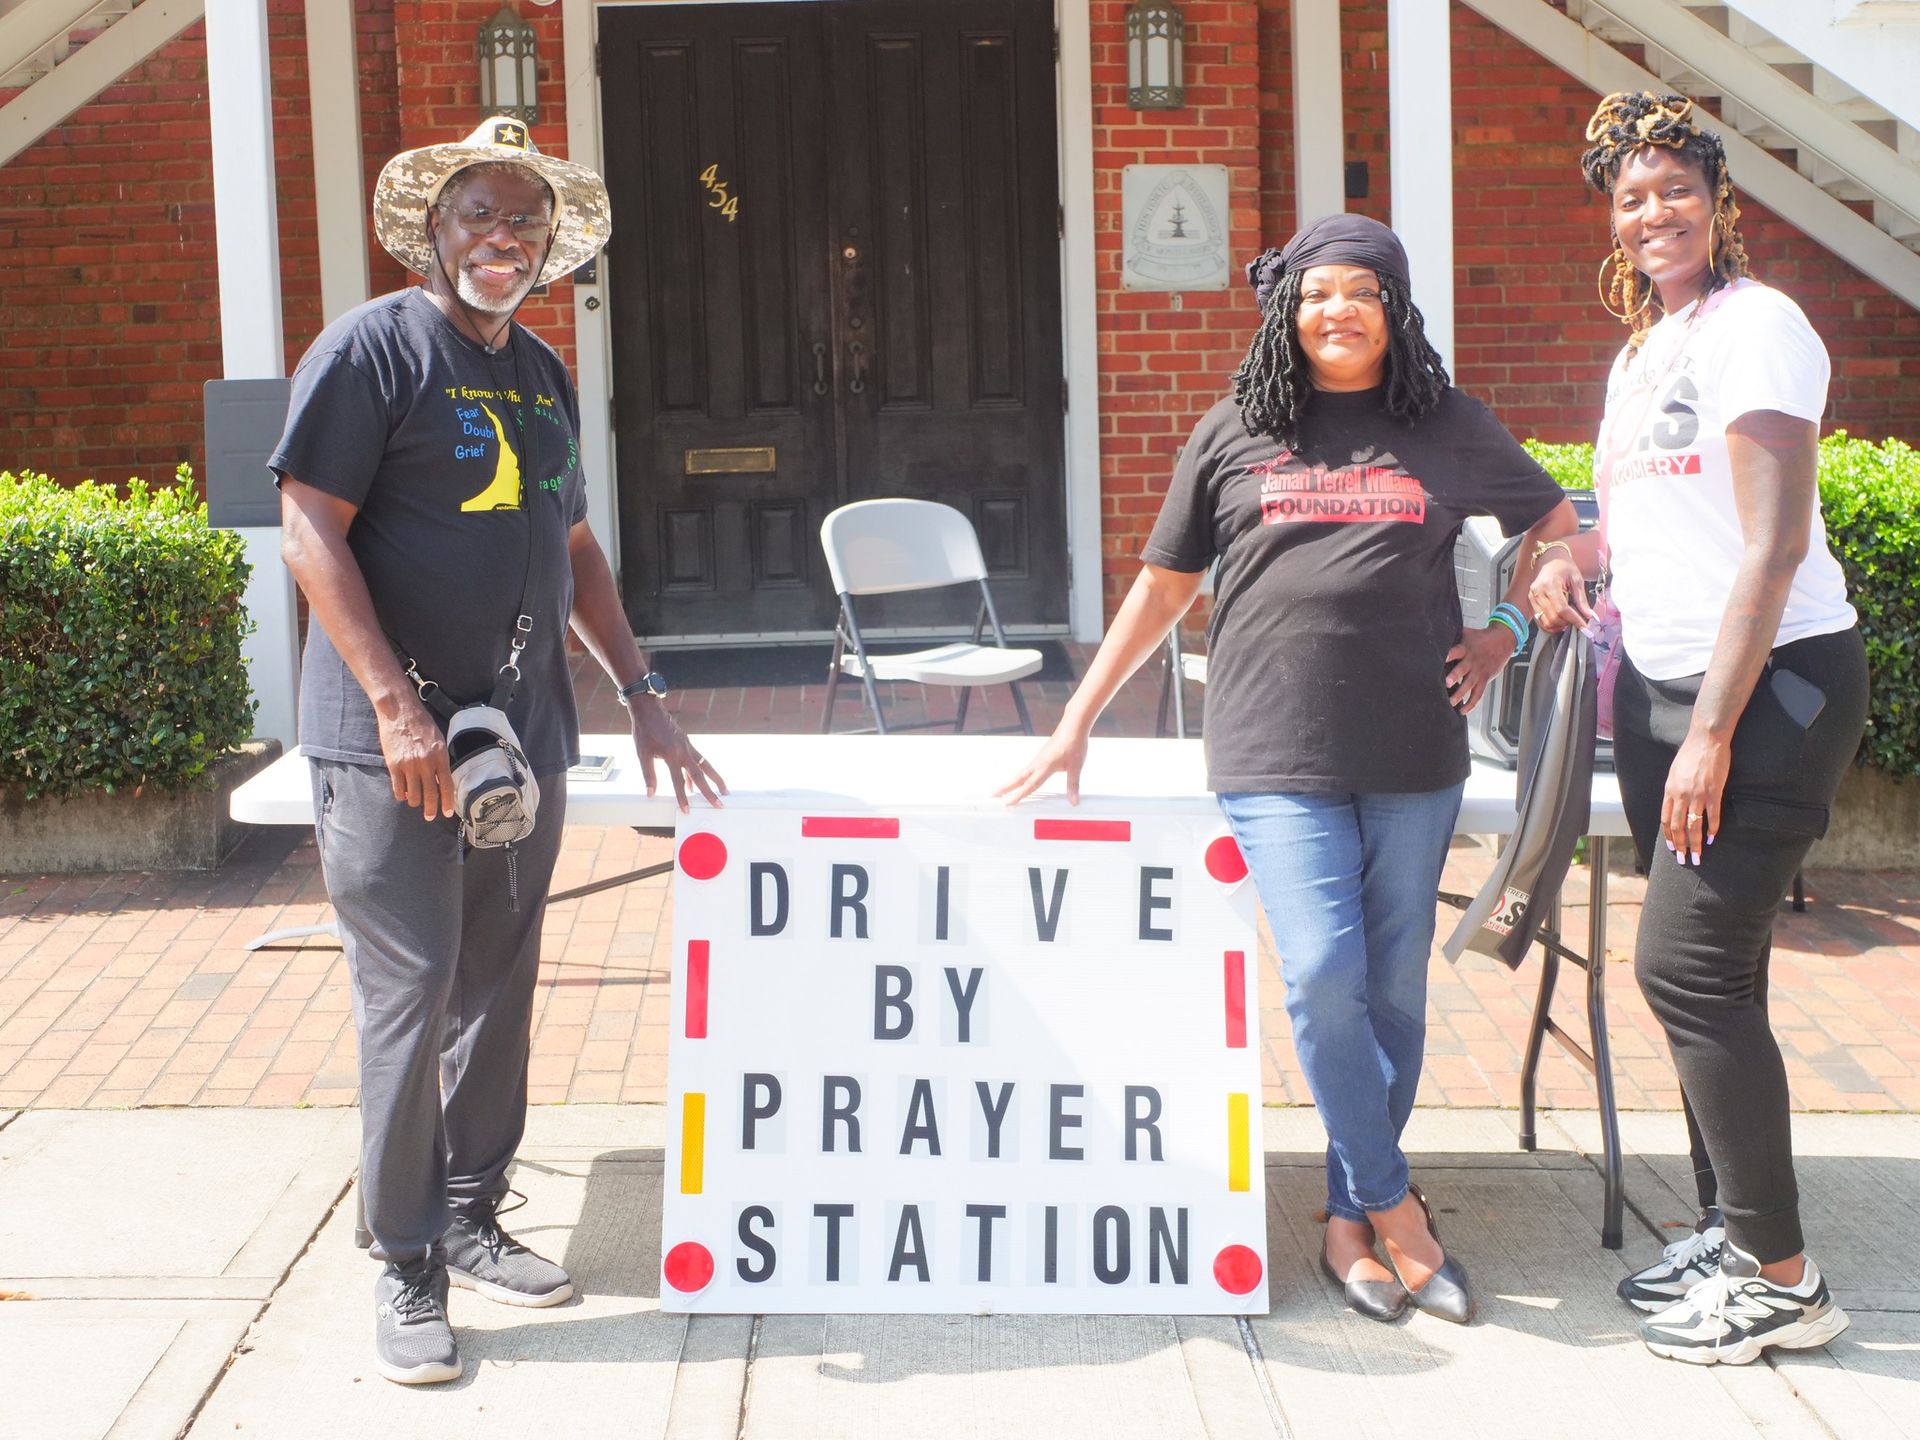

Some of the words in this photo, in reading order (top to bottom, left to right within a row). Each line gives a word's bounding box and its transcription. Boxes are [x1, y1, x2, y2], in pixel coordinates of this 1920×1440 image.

[699, 164, 738, 222] 454
[461, 386, 494, 401] know
[456, 408, 479, 421] Fear
[463, 422, 496, 439] Doubt
[455, 444, 485, 460] Grief
[1261, 468, 1311, 494] Jamari
[1313, 466, 1361, 493] Terrell
[1265, 497, 1421, 517] FOUNDATION
[750, 862, 1174, 942] DRIVE
[874, 965, 984, 1043] BY
[742, 1073, 1164, 1161] PRAYER
[736, 1204, 1189, 1286] STATION
